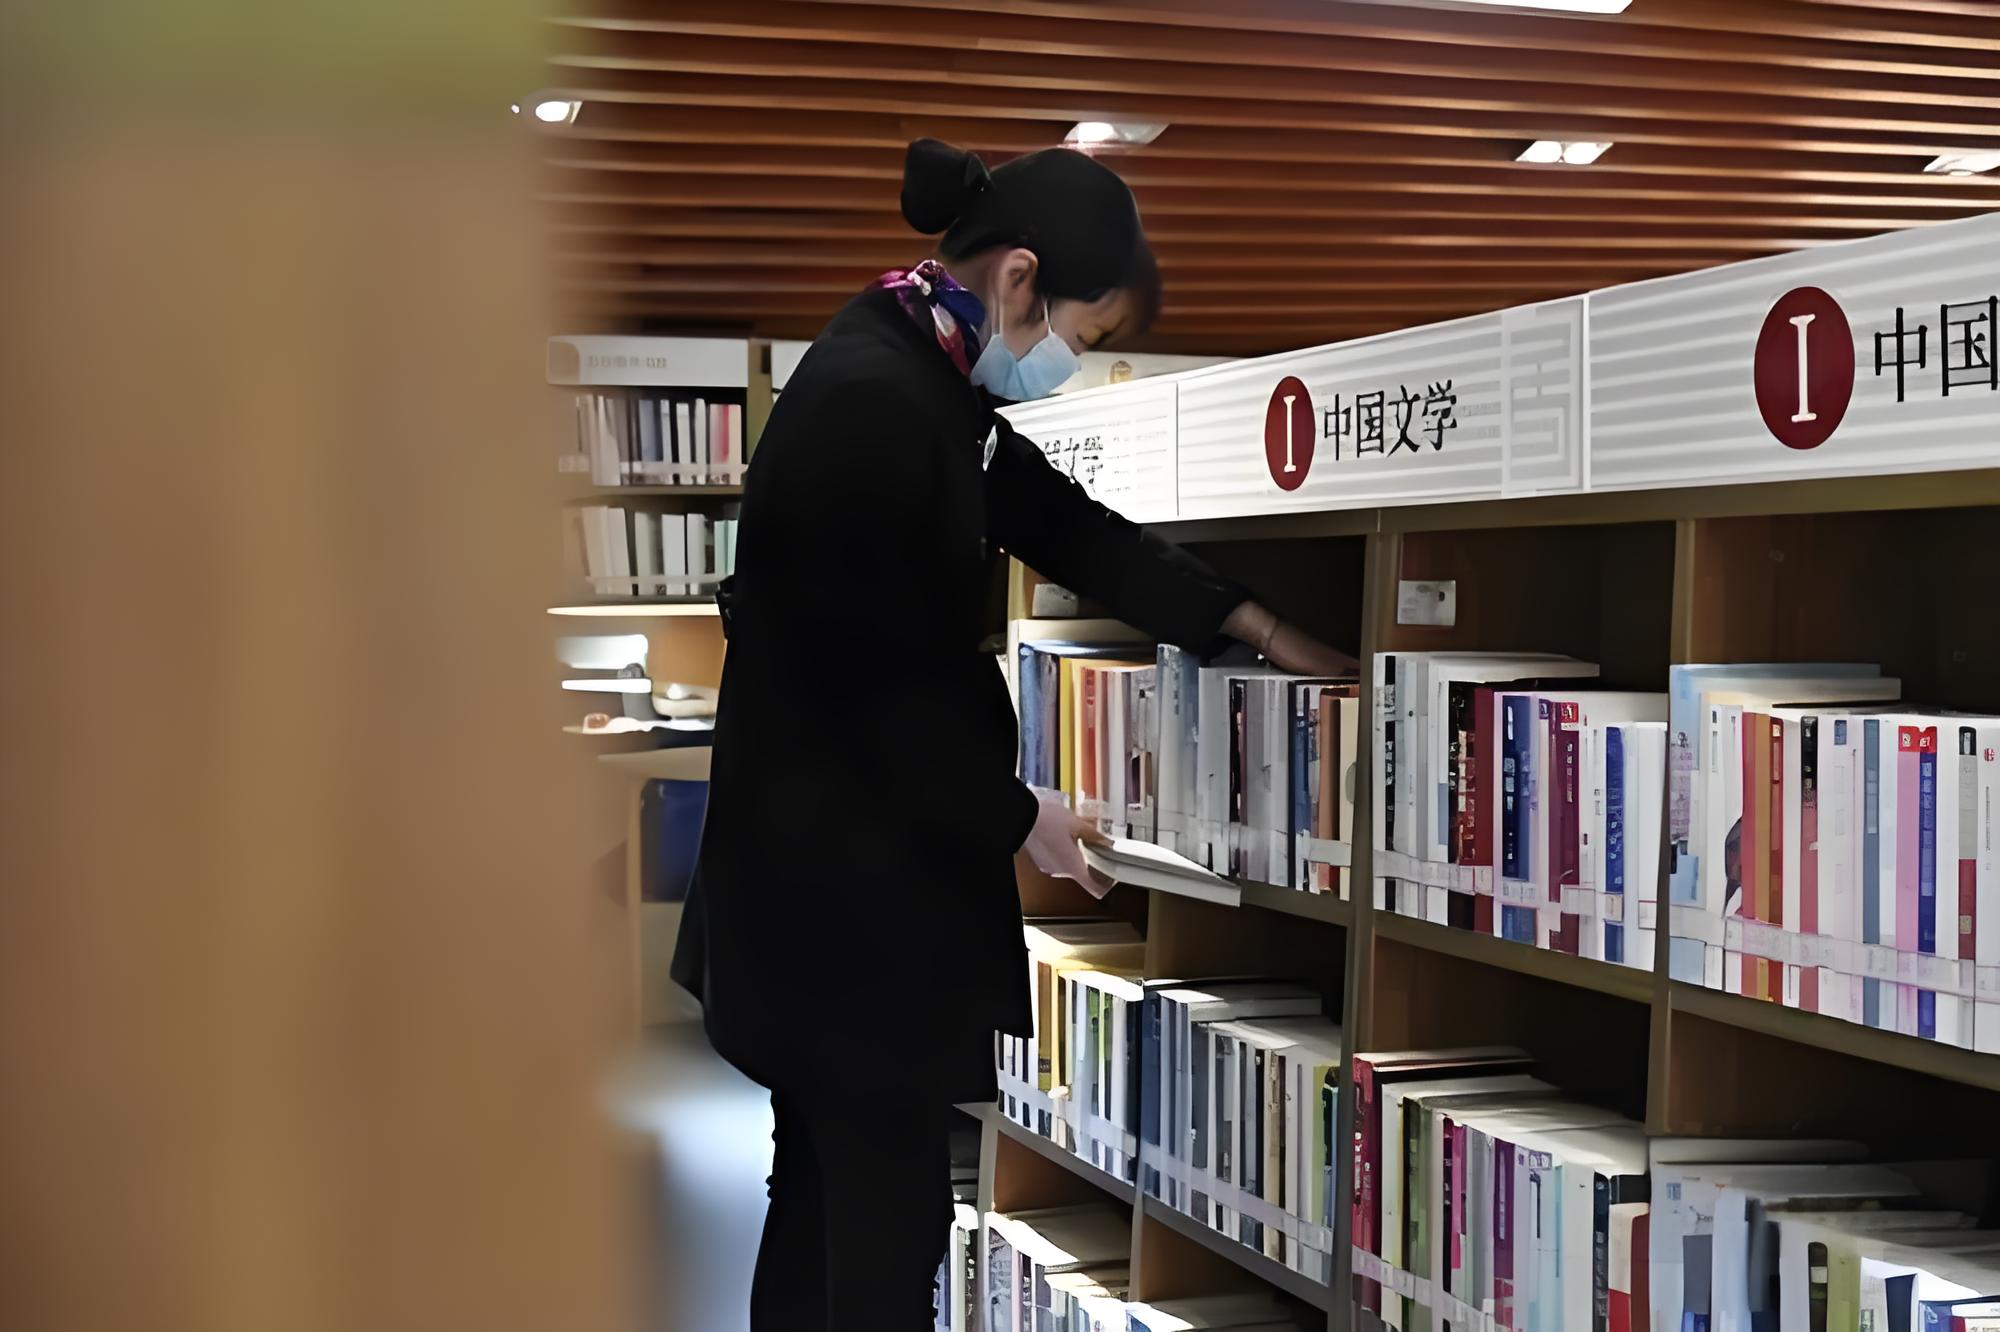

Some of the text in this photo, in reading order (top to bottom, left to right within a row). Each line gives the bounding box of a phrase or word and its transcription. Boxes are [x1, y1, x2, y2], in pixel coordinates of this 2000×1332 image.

[1789, 313, 1817, 423] I
[1874, 295, 1999, 403] 中国
[1282, 394, 1297, 473] I
[1323, 378, 1458, 462] 中国文学
